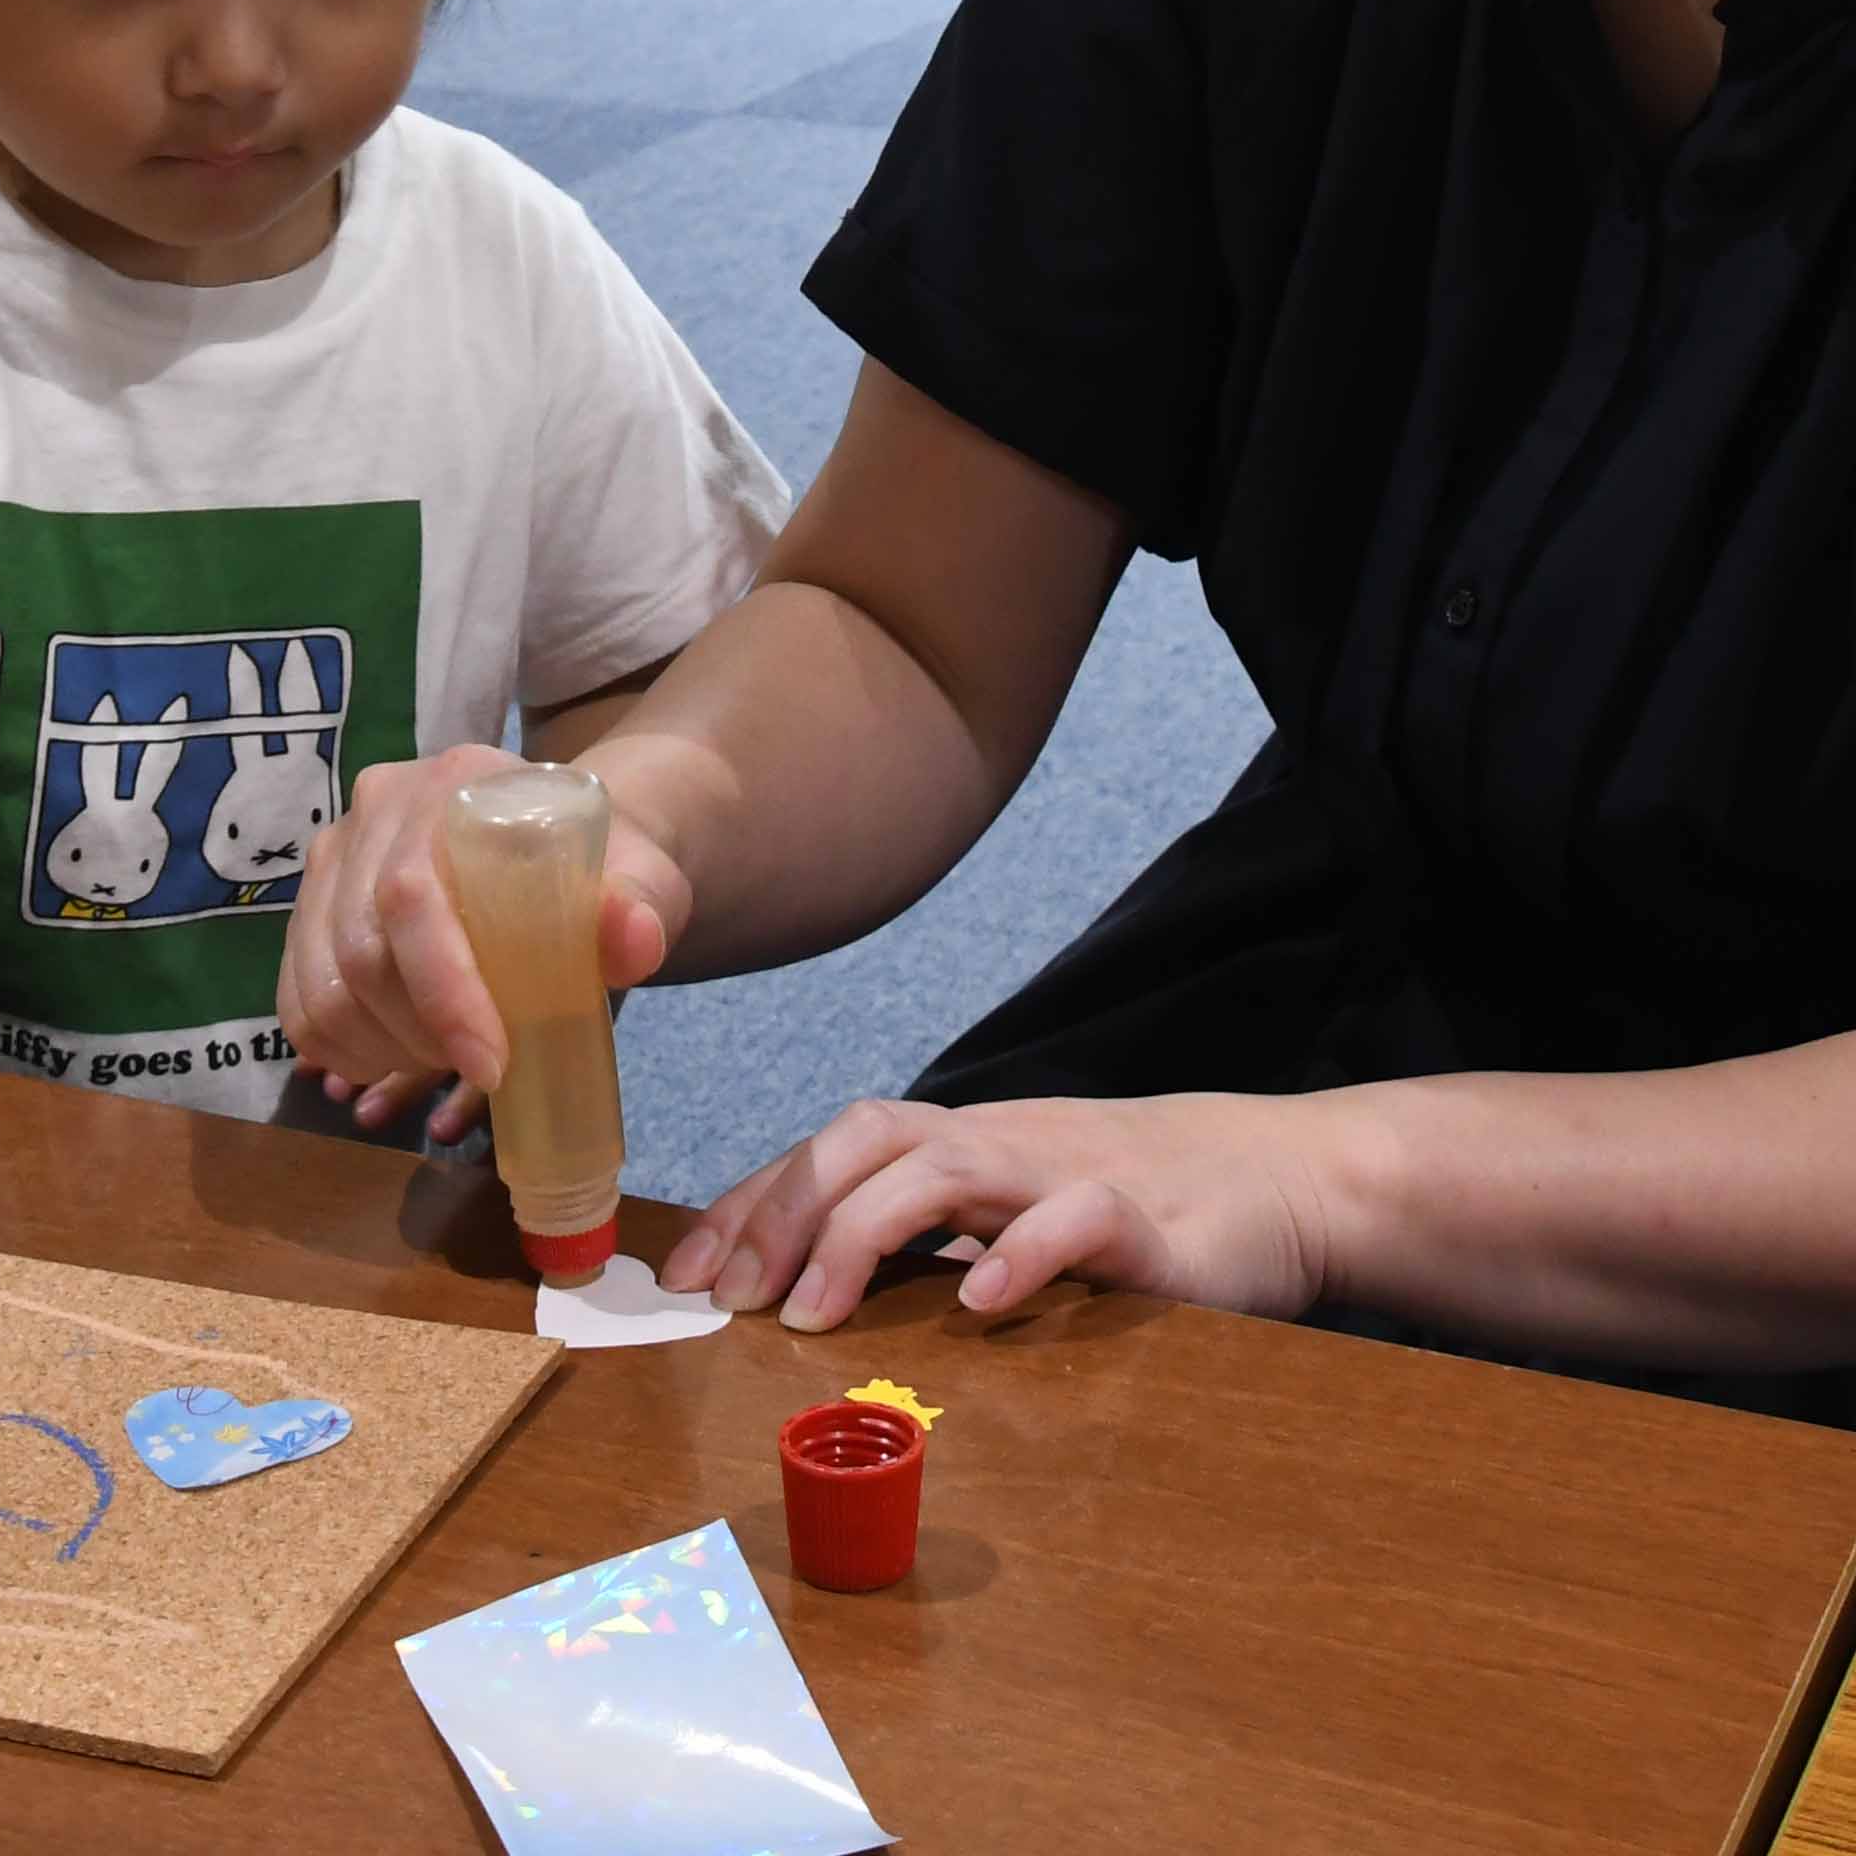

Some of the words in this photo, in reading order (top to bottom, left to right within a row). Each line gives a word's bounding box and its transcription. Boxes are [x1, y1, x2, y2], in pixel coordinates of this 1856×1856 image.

[89, 1049, 193, 1086] goes
[205, 1040, 242, 1071] to
[249, 1027, 298, 1062] th
